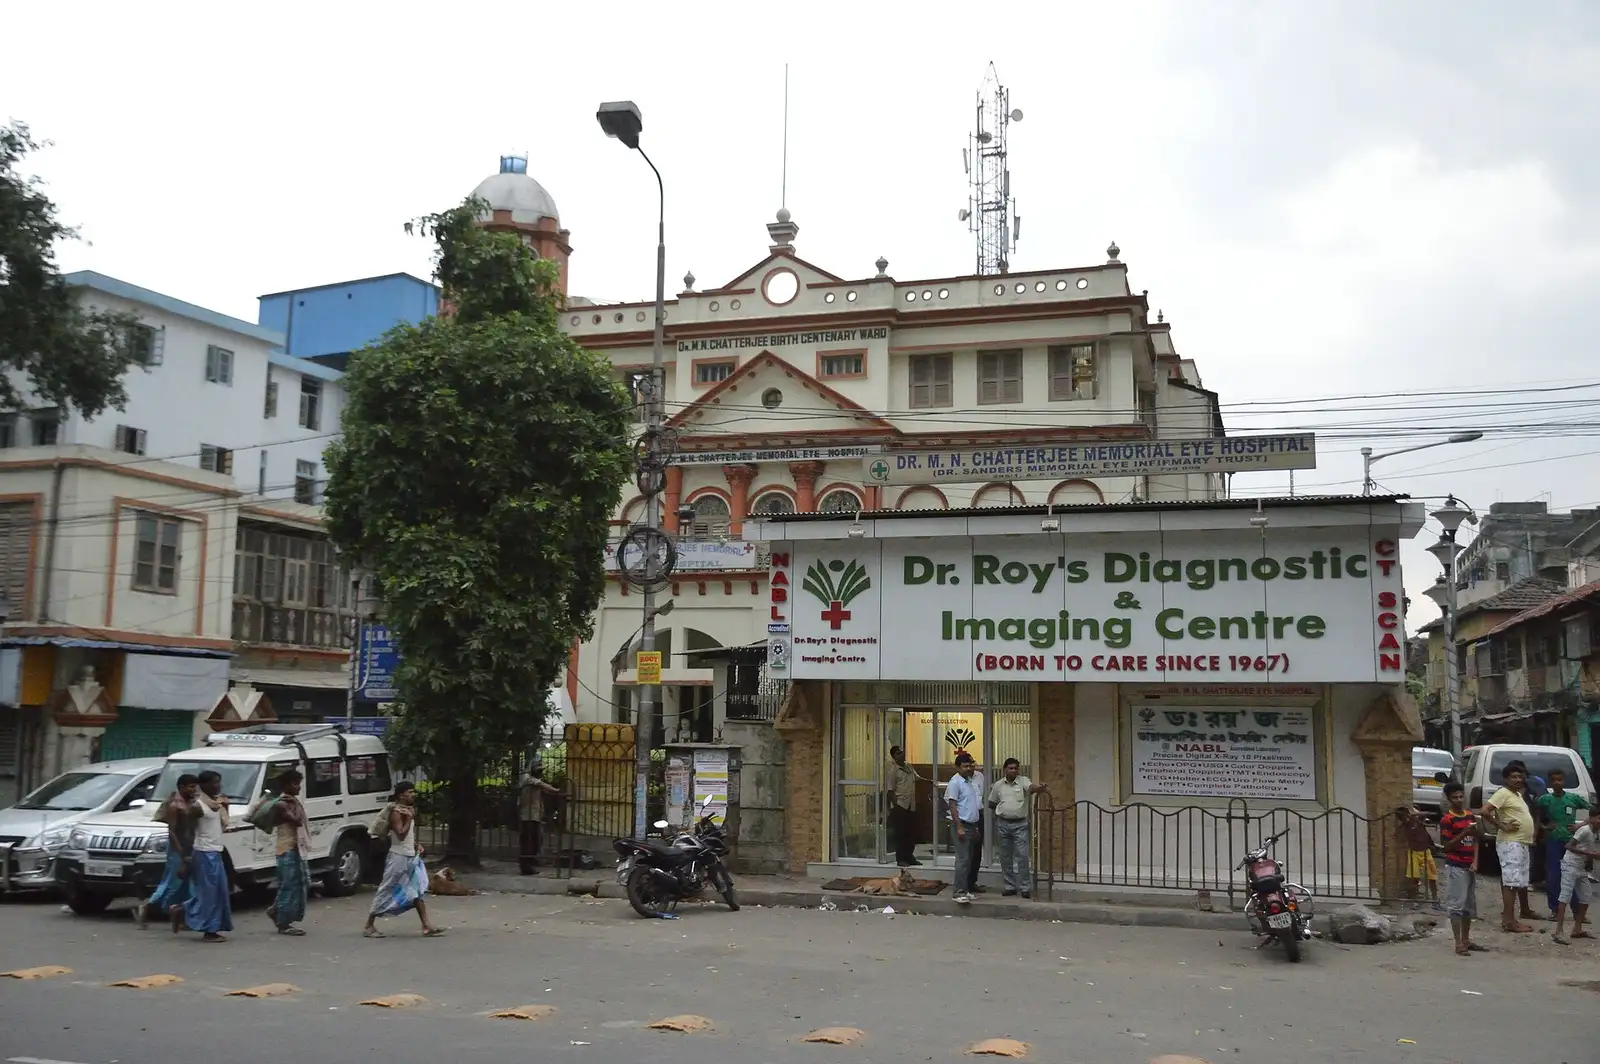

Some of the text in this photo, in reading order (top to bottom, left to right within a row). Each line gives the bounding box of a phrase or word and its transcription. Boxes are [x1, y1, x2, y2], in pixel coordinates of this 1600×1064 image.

[770, 333, 798, 346] BIRTH
[801, 330, 857, 344] CENTENARY
[859, 328, 887, 340] WARD
[756, 450, 800, 460] MEMORIAL
[803, 449, 820, 458] EYE
[896, 437, 1310, 470] DR. M. N. CHATTERJEE MEMORIAL EYE HOSPITAL
[962, 466, 1022, 475] SANDERS
[1027, 463, 1098, 472] MEMORIAL
[1103, 461, 1129, 469] EYE
[1134, 457, 1211, 467] INFIRMARY
[1215, 455, 1268, 464] TRUST)
[903, 547, 1368, 594] Dr. Roy's Diagnostic
[771, 553, 789, 620] NABL
[1113, 591, 1142, 610] &
[1374, 539, 1401, 671] CT SCAN
[942, 607, 1326, 649] Imaging Centre
[830, 637, 877, 645] Diagnostic
[802, 655, 866, 664] Imaging Centre
[975, 653, 1290, 674] (BORN TO CARE SINCE 1967)
[1175, 743, 1227, 753] NABL
[1256, 770, 1311, 778] Endoscopy
